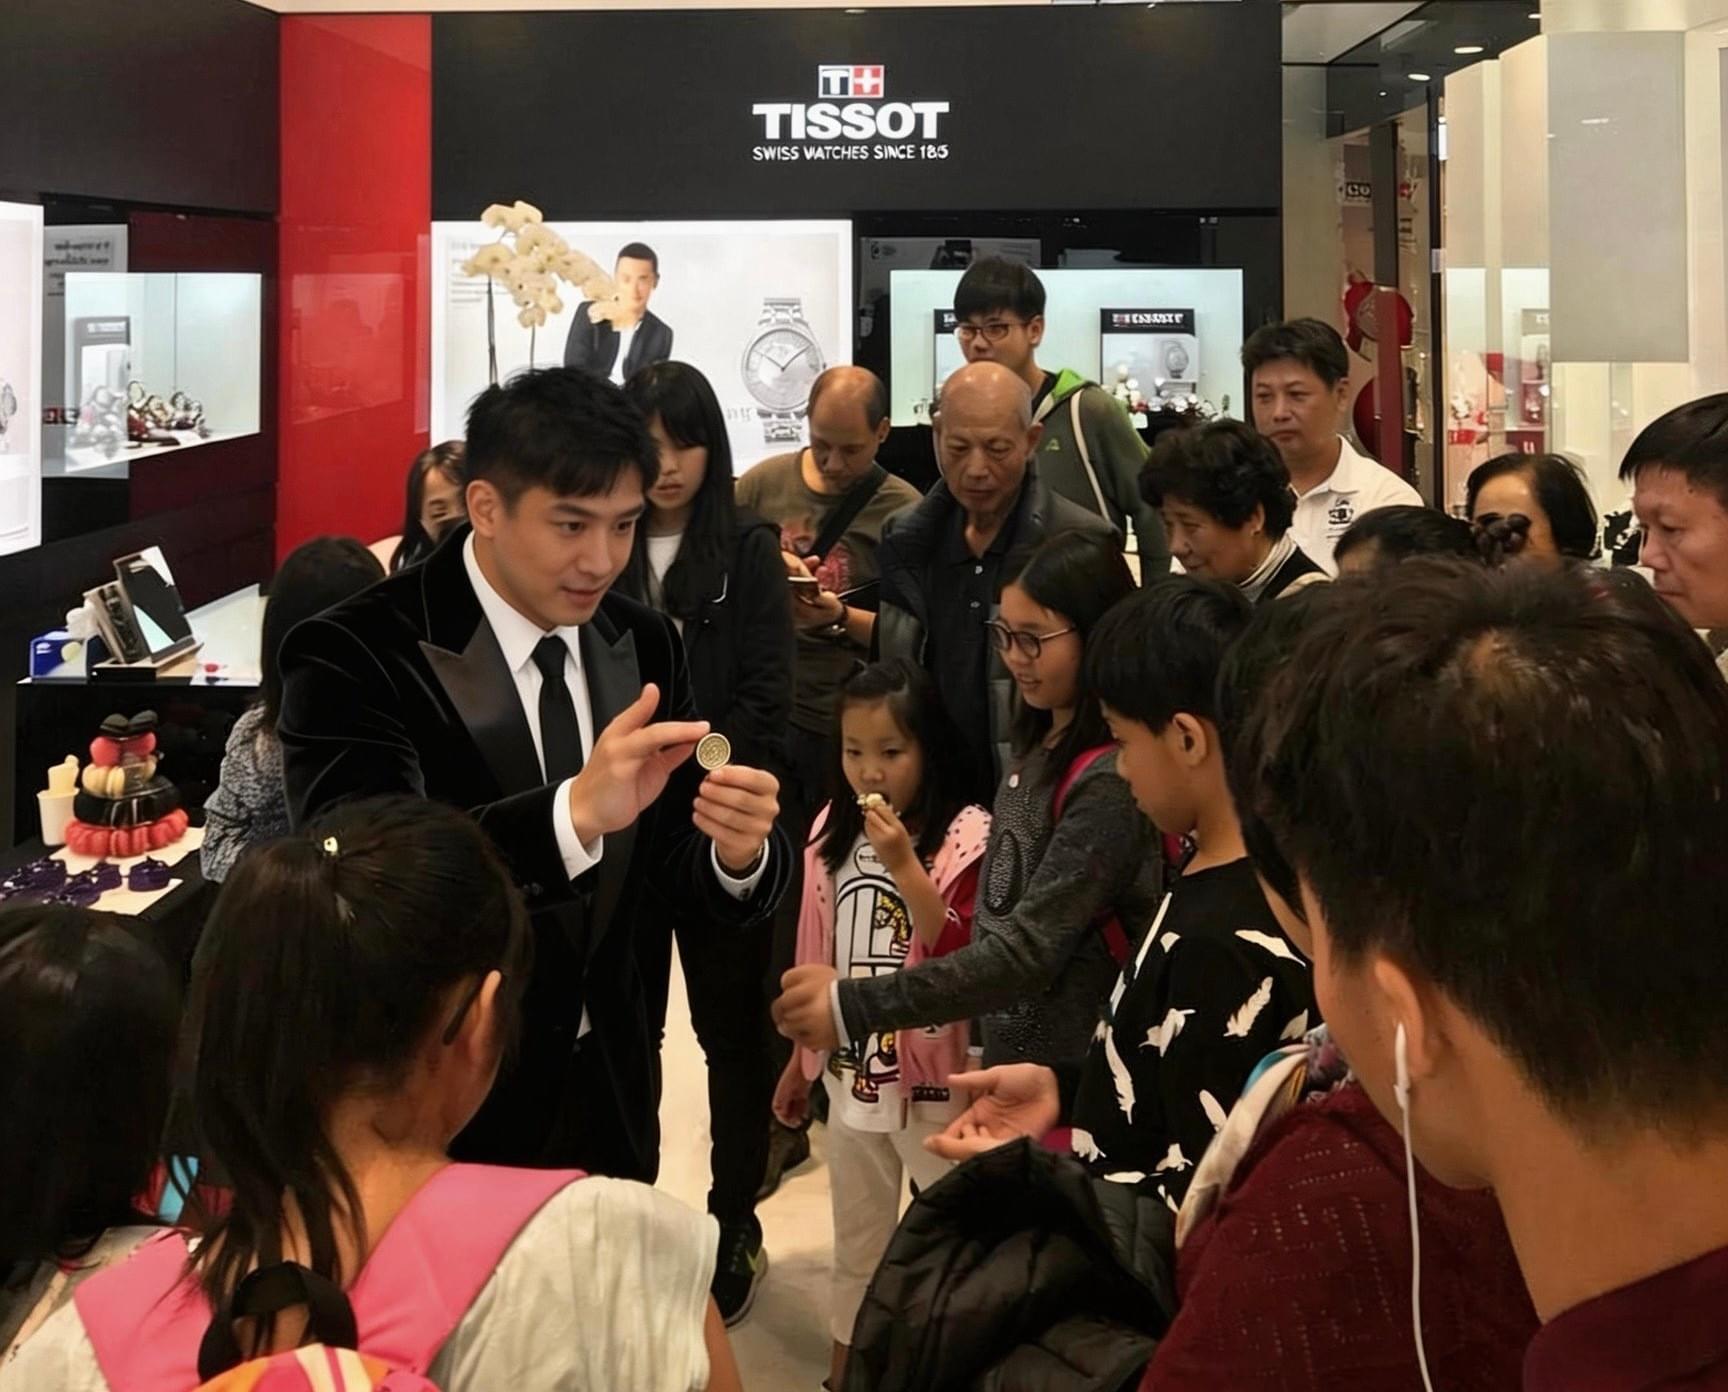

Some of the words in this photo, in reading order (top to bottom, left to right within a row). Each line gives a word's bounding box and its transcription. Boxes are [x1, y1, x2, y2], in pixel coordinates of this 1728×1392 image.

[752, 101, 950, 139] TISSOT
[752, 144, 800, 161] SWISS
[802, 144, 870, 160] WATCHES
[873, 144, 916, 160] SINCE
